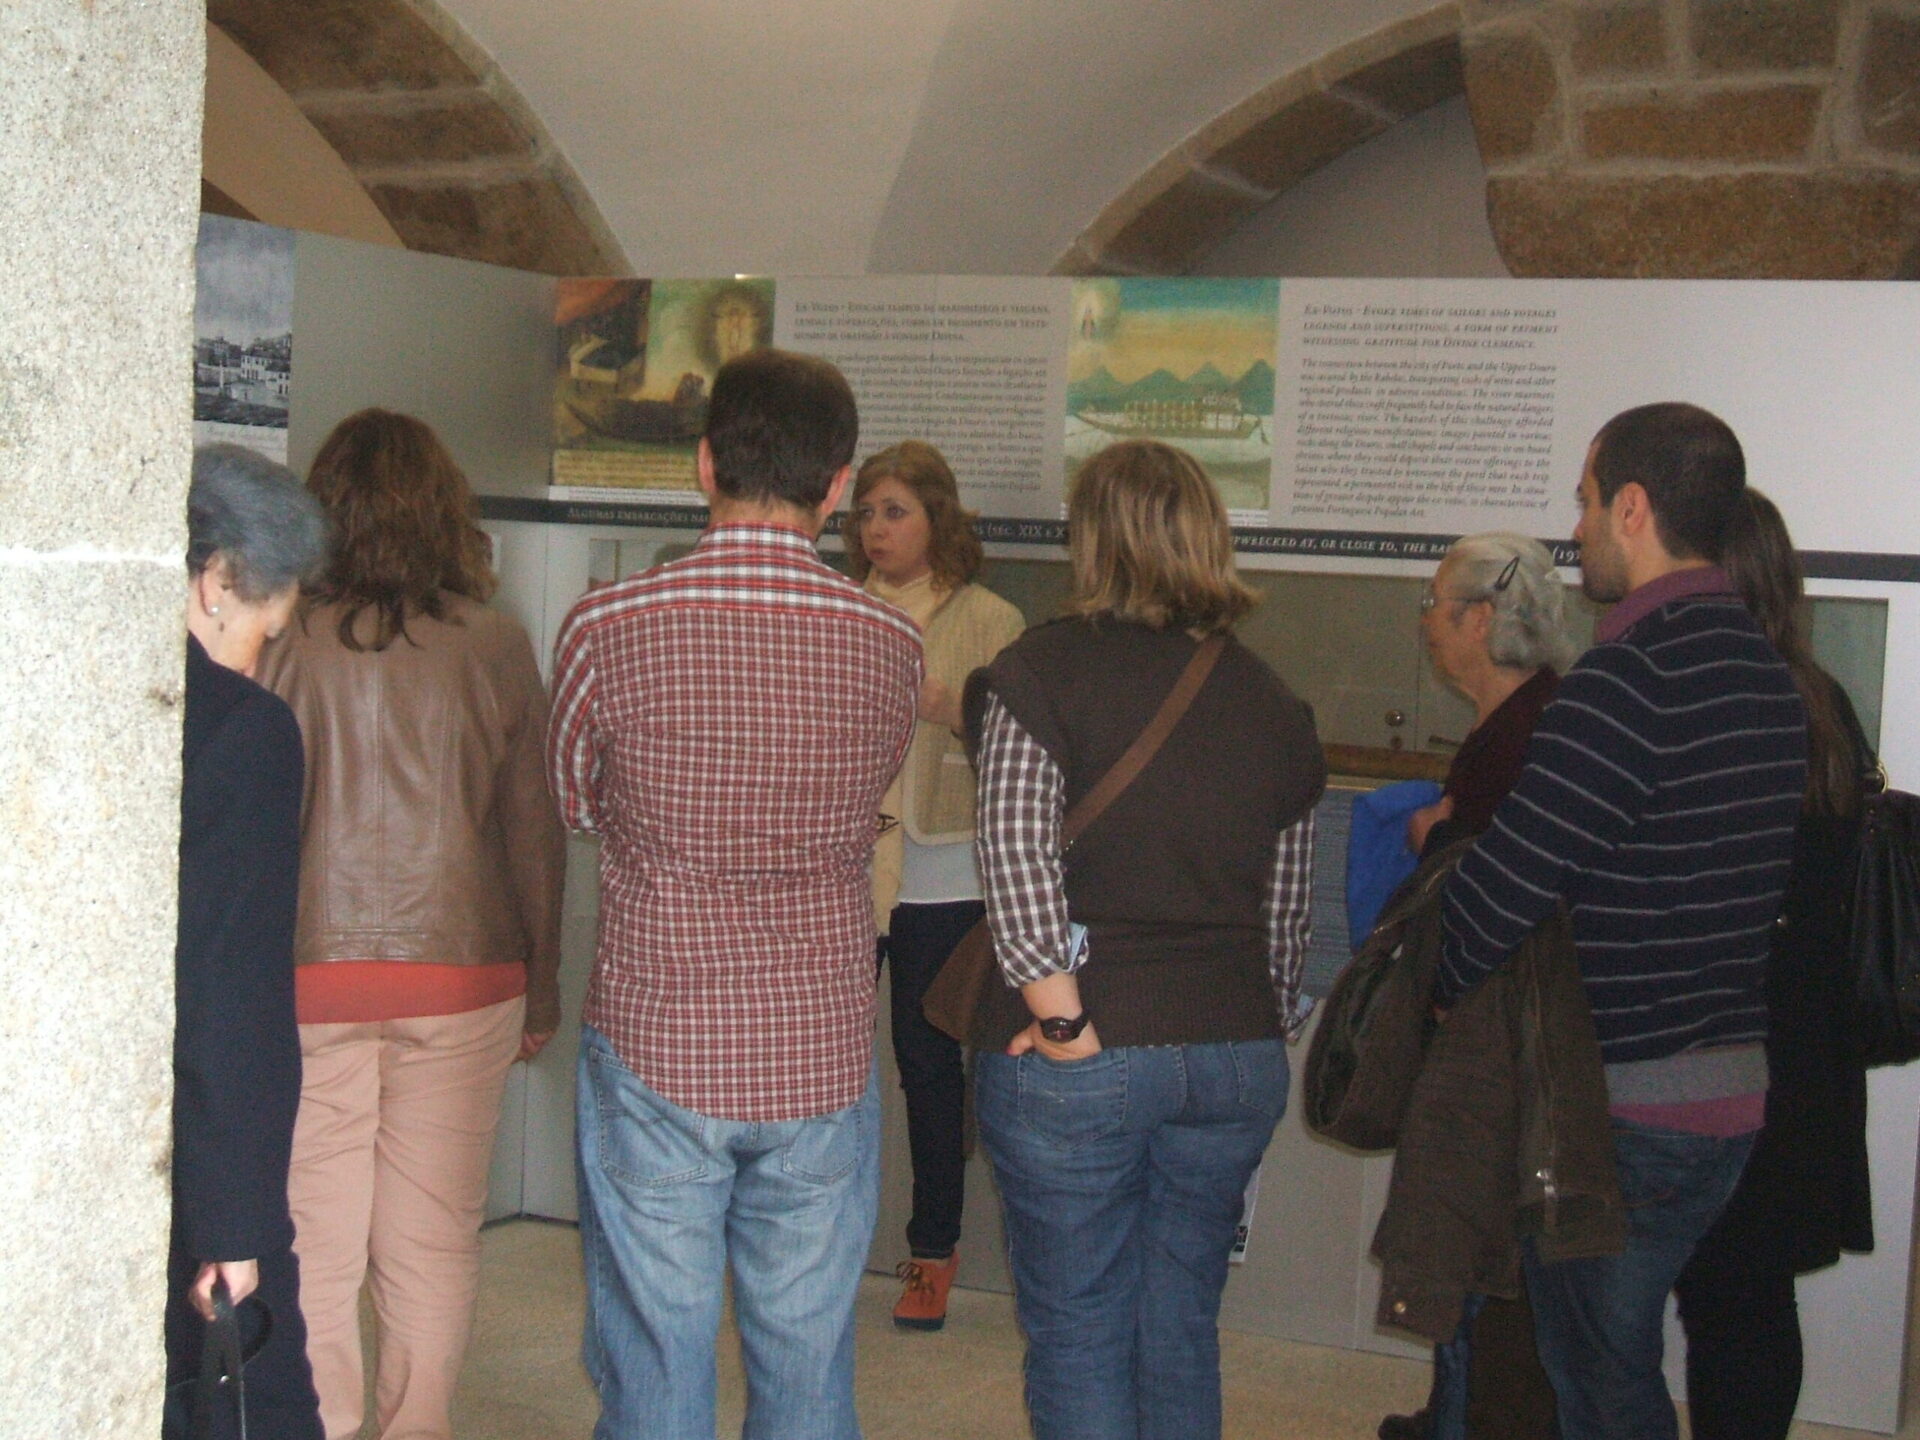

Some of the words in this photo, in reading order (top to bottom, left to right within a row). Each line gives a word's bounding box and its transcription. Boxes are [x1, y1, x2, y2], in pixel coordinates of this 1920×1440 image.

[1053, 524, 1067, 538] X
[1232, 534, 1298, 549] PWRECKED
[1299, 538, 1318, 550] AT,
[1320, 538, 1337, 550] OR
[1339, 539, 1376, 552] CLOSE
[1378, 541, 1398, 553] TO,
[1402, 542, 1427, 554] THE
